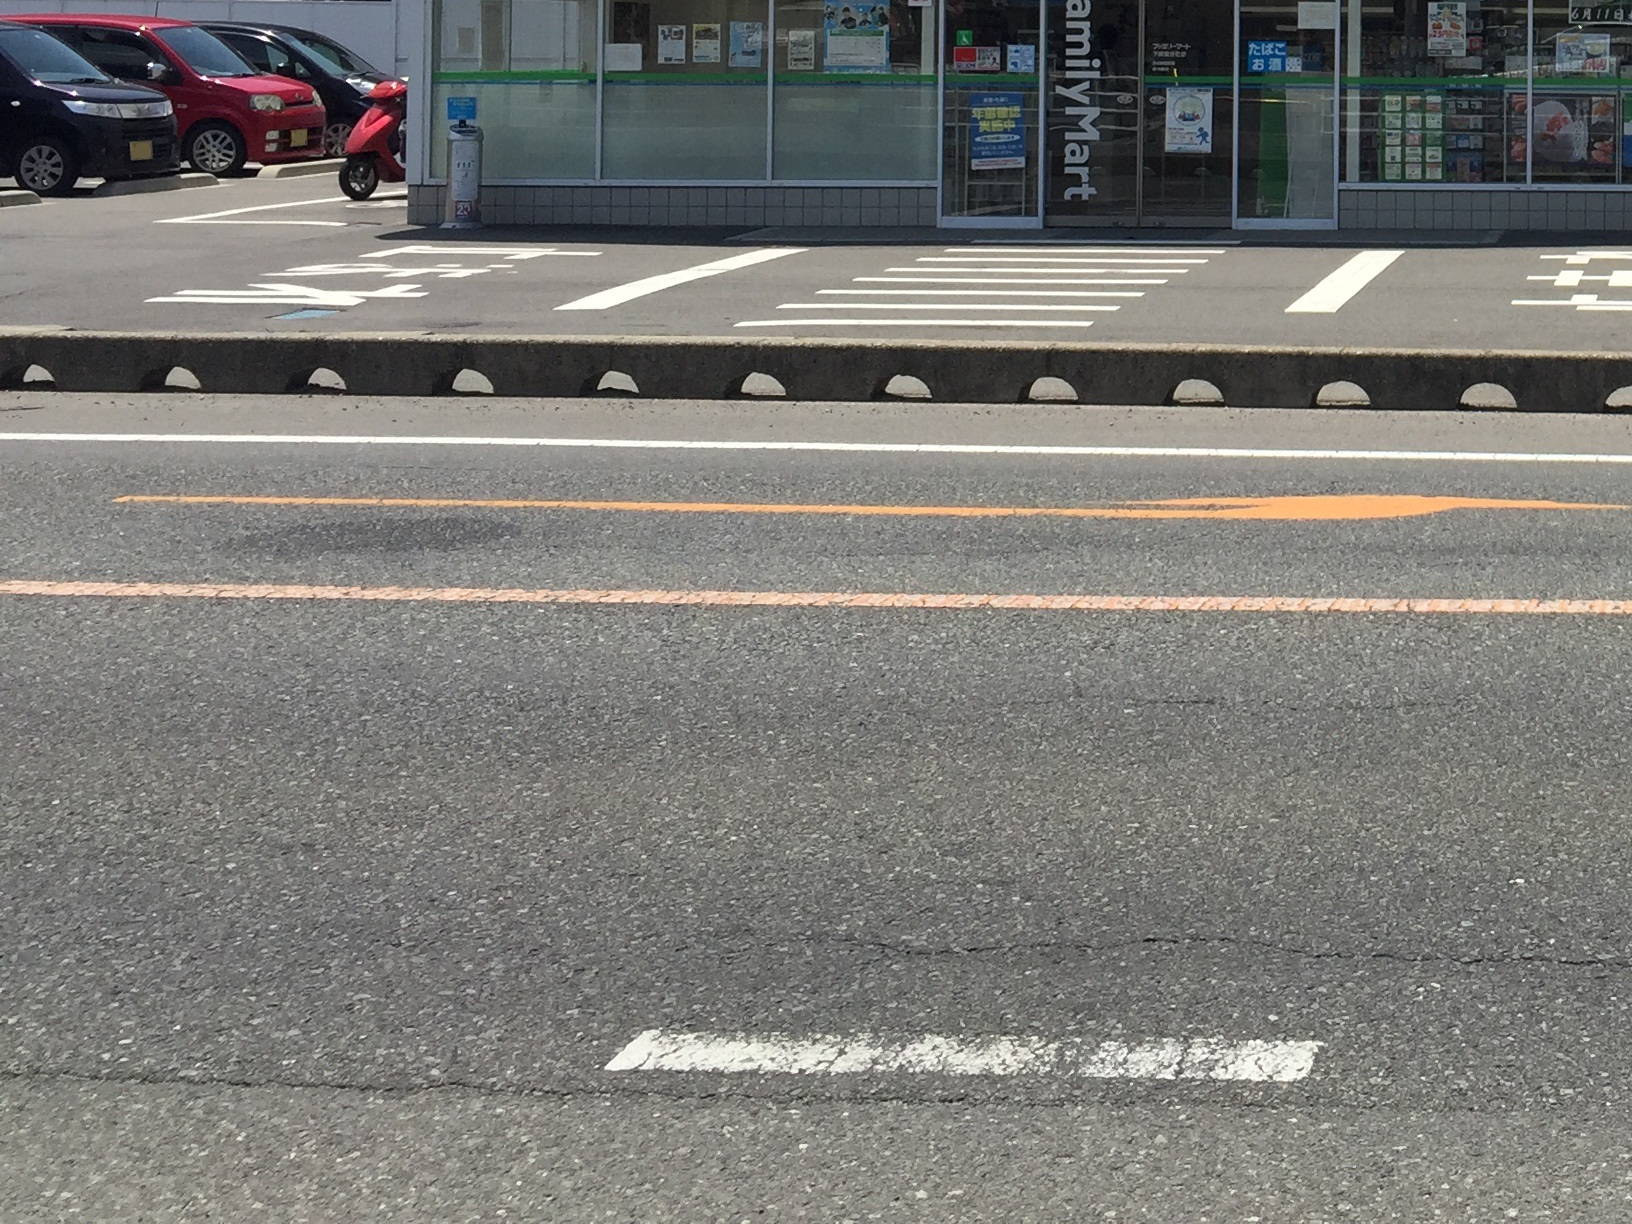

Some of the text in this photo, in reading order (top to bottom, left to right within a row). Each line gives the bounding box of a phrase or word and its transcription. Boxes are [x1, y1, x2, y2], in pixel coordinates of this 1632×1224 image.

[1248, 42, 1287, 56] たばこ
[1252, 57, 1282, 71] お酒
